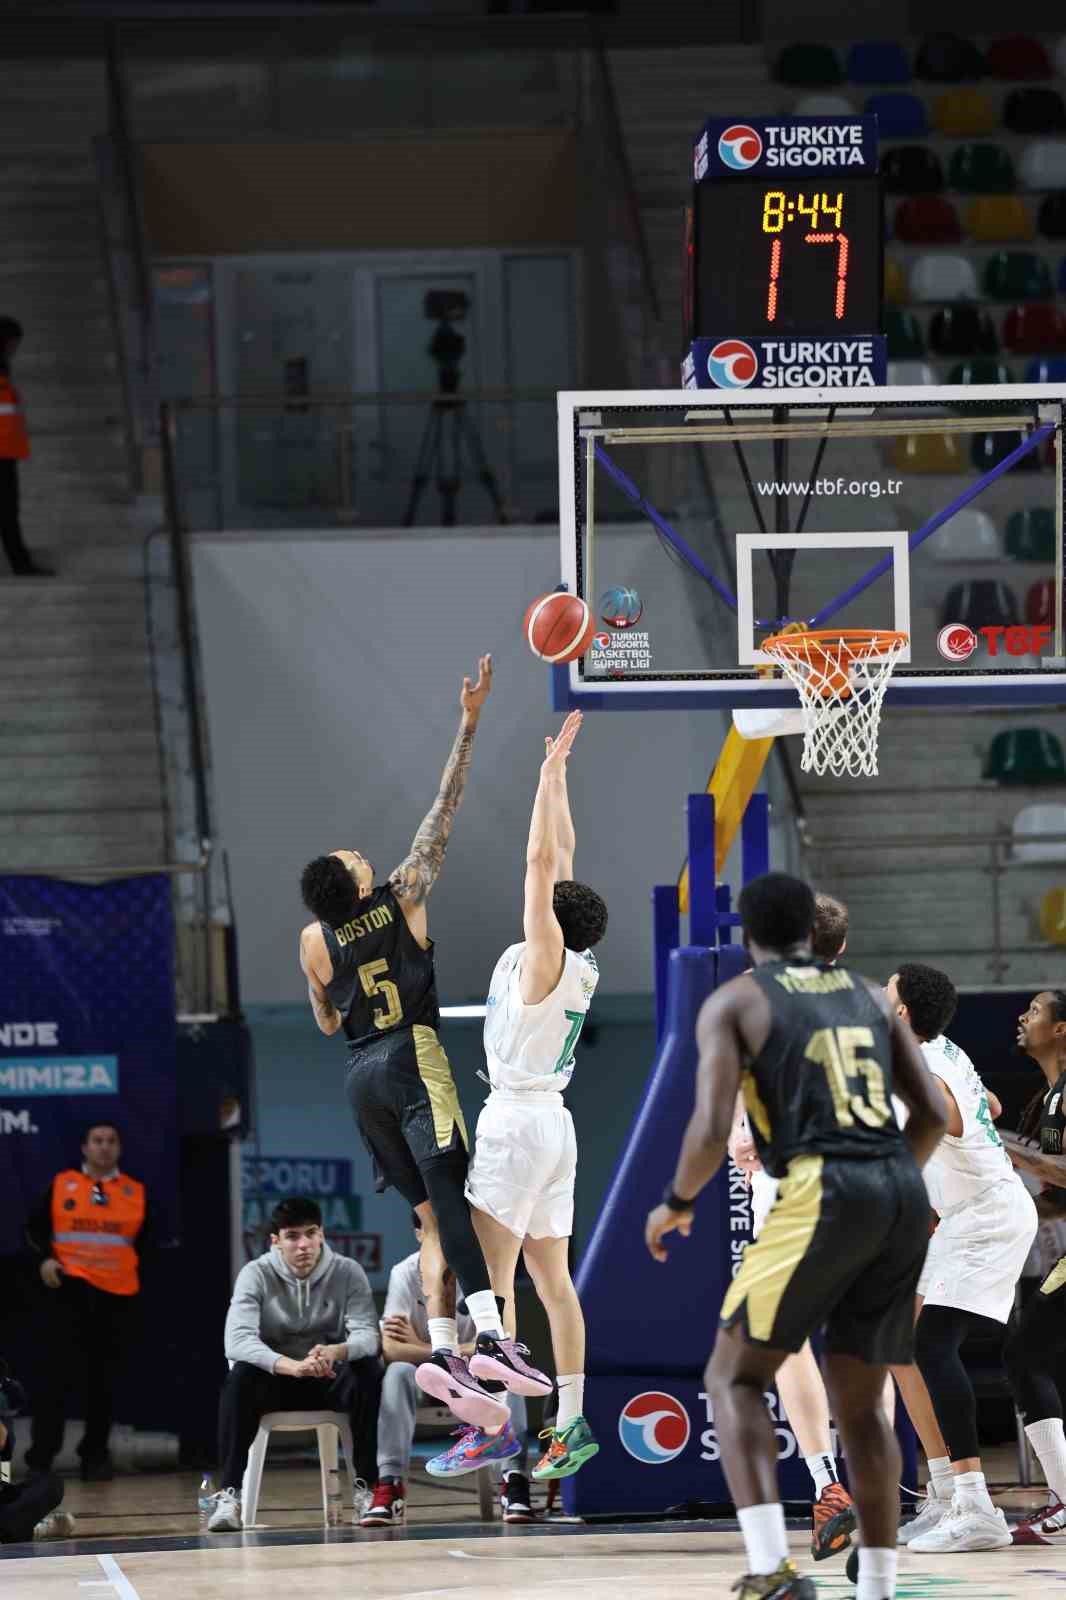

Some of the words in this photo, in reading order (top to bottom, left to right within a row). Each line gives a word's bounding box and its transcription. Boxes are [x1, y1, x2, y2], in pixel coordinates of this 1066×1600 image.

[762, 191, 844, 233] 8:44
[766, 233, 849, 321] 17
[757, 478, 903, 498] www.tbf.org.tr
[591, 649, 652, 659] BASKETBOL
[979, 625, 1051, 657] TBF
[335, 904, 393, 947] BOSTON
[357, 957, 404, 1030] 5
[804, 1026, 892, 1128] 15
